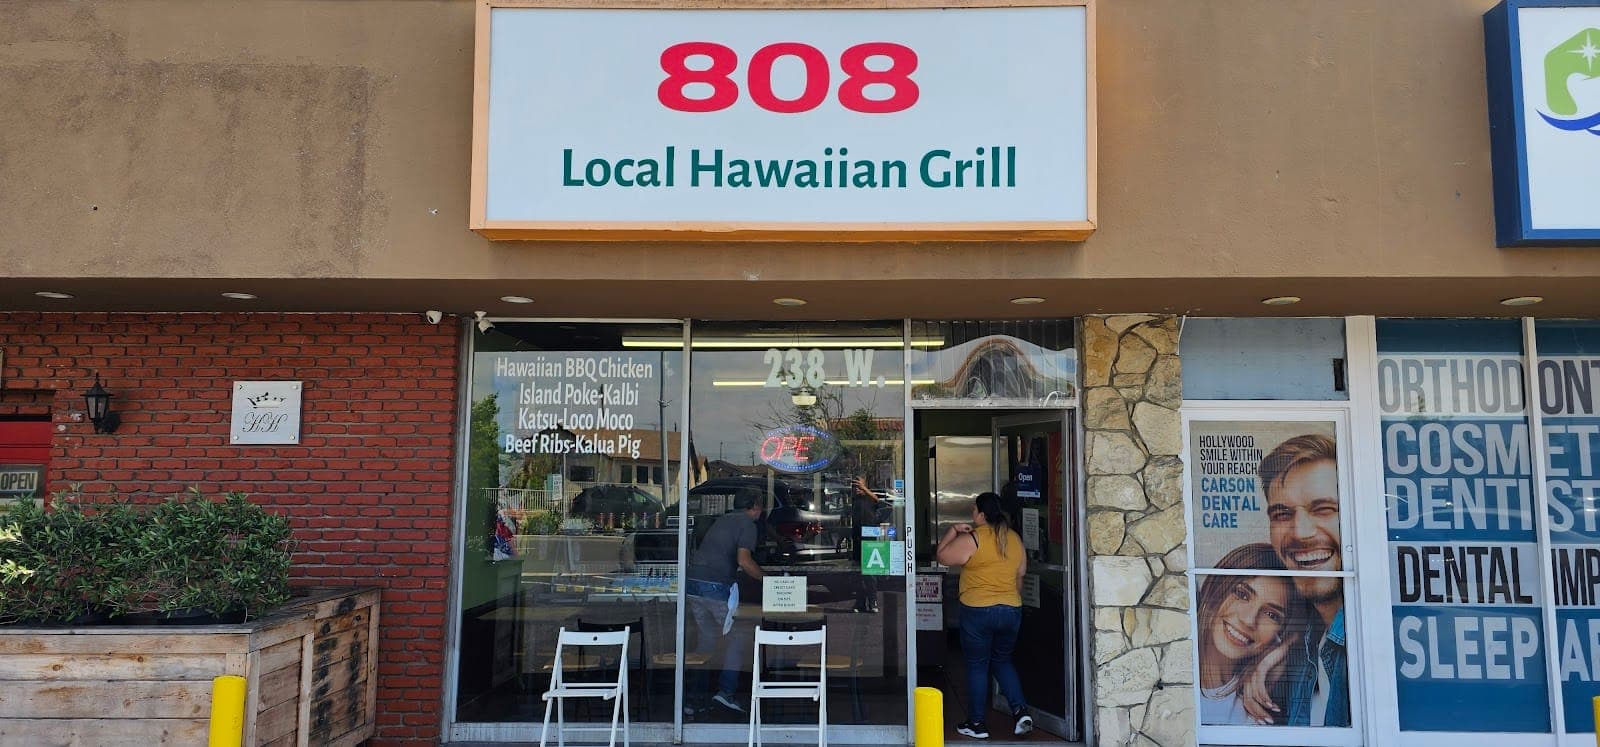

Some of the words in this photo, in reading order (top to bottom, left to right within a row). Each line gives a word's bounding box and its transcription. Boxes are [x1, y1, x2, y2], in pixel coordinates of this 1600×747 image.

[657, 41, 920, 114] 808
[562, 145, 675, 188] Local
[691, 147, 907, 189] Hawaiian
[919, 145, 1017, 188] Grill
[496, 356, 562, 377] Hawaiian
[565, 357, 598, 382] BBQ
[599, 356, 653, 379] Chicken
[763, 347, 826, 389] 238
[844, 348, 886, 389] W.
[519, 382, 562, 406] Island
[565, 382, 639, 406] Poke-Kalbi
[1378, 357, 1600, 415] ORTHODON
[518, 407, 594, 431] Katsu-Loco
[596, 407, 634, 431] Moco
[505, 433, 538, 454] Beef
[540, 434, 615, 455] Ribs-Kalua
[618, 433, 642, 460] Pig
[1199, 435, 1254, 448] HOLLYWOOD
[1200, 448, 1227, 461] SMILE
[1230, 448, 1263, 461] WITHIN
[1018, 472, 1033, 483] Open
[1201, 462, 1225, 475] YOUR
[1227, 462, 1257, 475] REACH
[0, 472, 35, 490] OPEN
[1201, 477, 1255, 493] CARSON
[1201, 495, 1261, 511] DENTAL
[1202, 512, 1238, 528] CARE
[866, 547, 885, 569] A
[906, 526, 914, 574] PUSH
[1397, 546, 1533, 604] DENTAL
[1399, 615, 1539, 680] SLEEP
